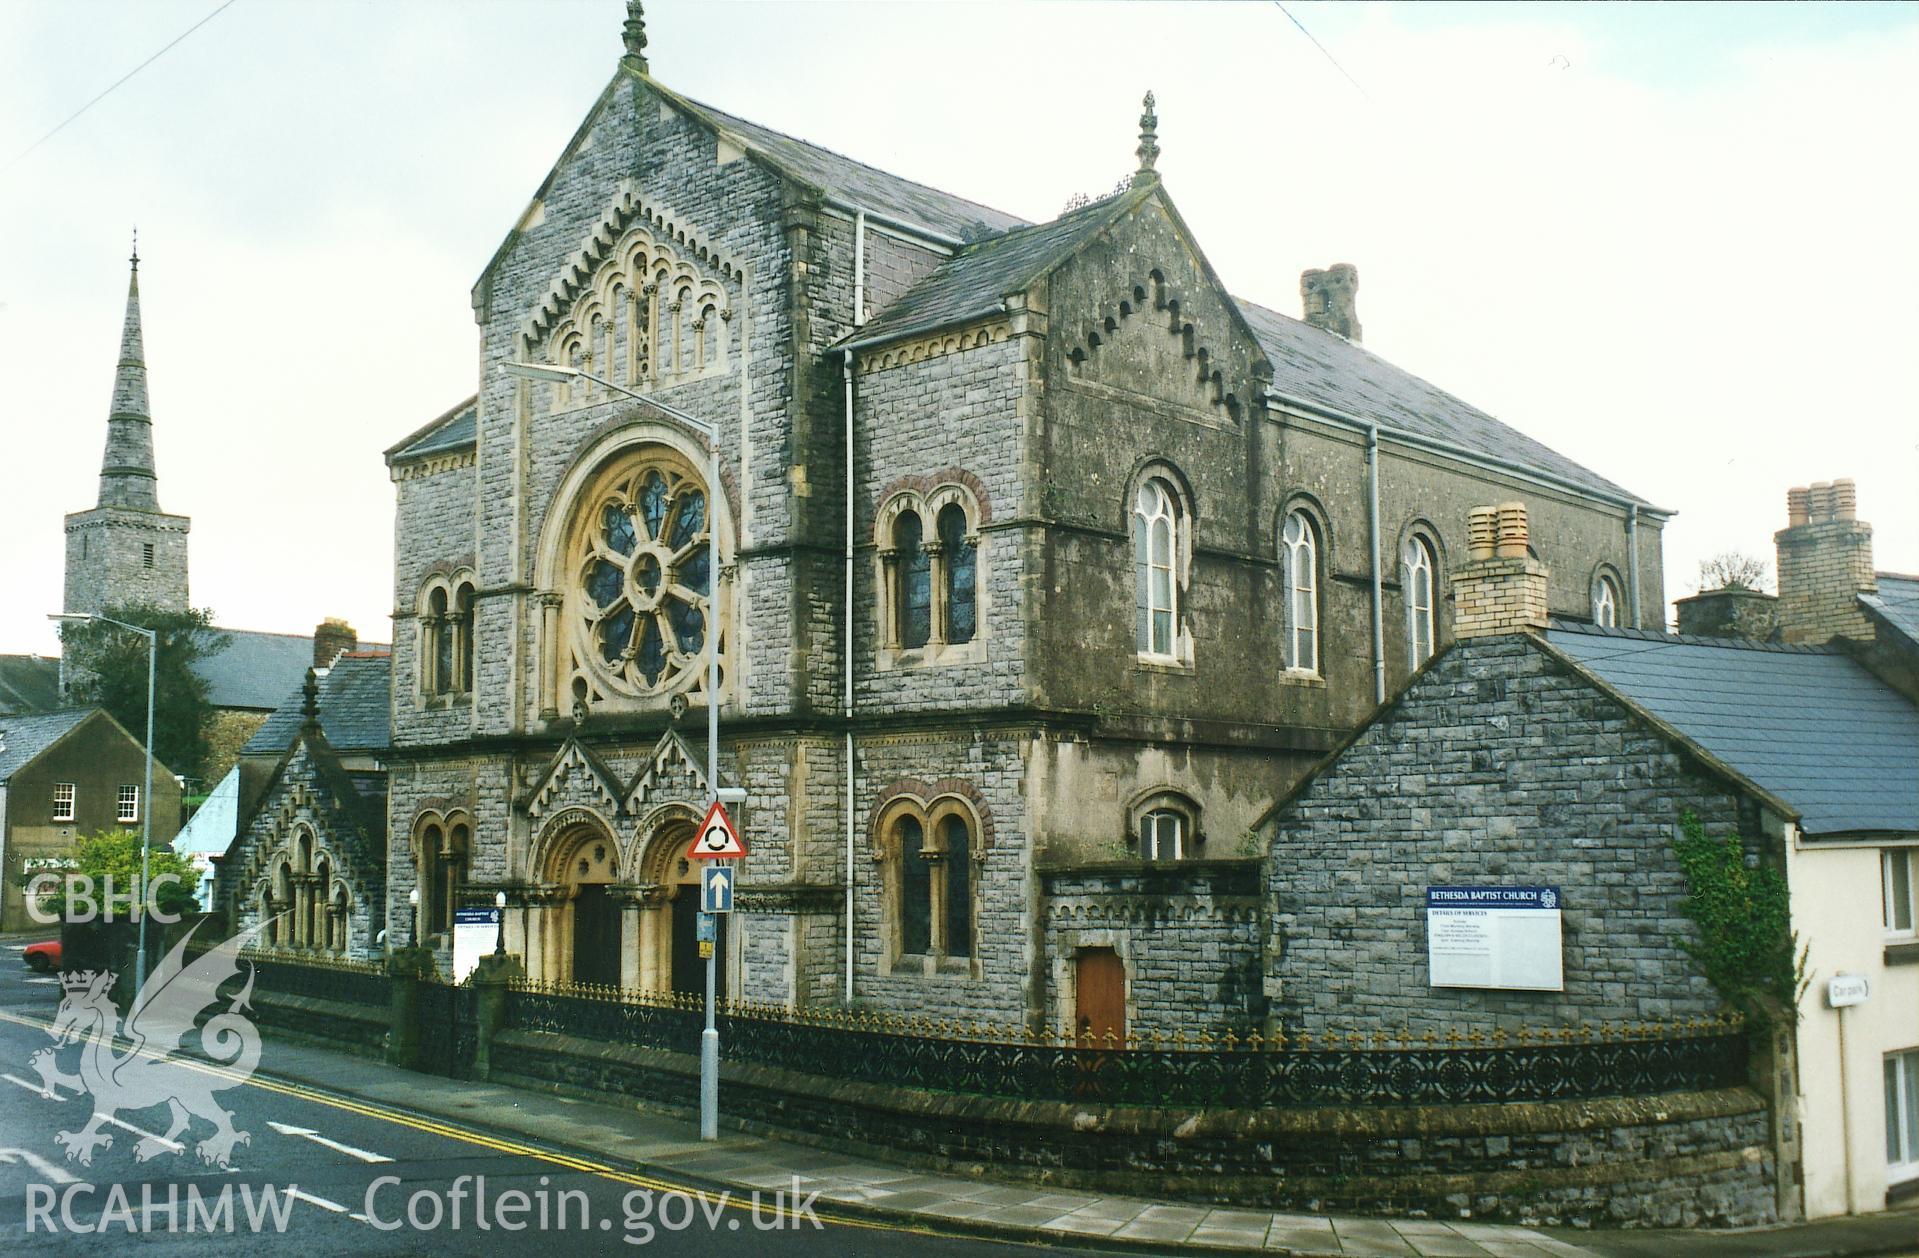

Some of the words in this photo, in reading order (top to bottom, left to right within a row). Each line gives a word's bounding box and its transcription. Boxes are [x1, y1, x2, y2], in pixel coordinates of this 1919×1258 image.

[1431, 891, 1469, 900] BETHESDA
[1471, 892, 1501, 900] BAPTIST
[1502, 892, 1537, 900] CHURCH
